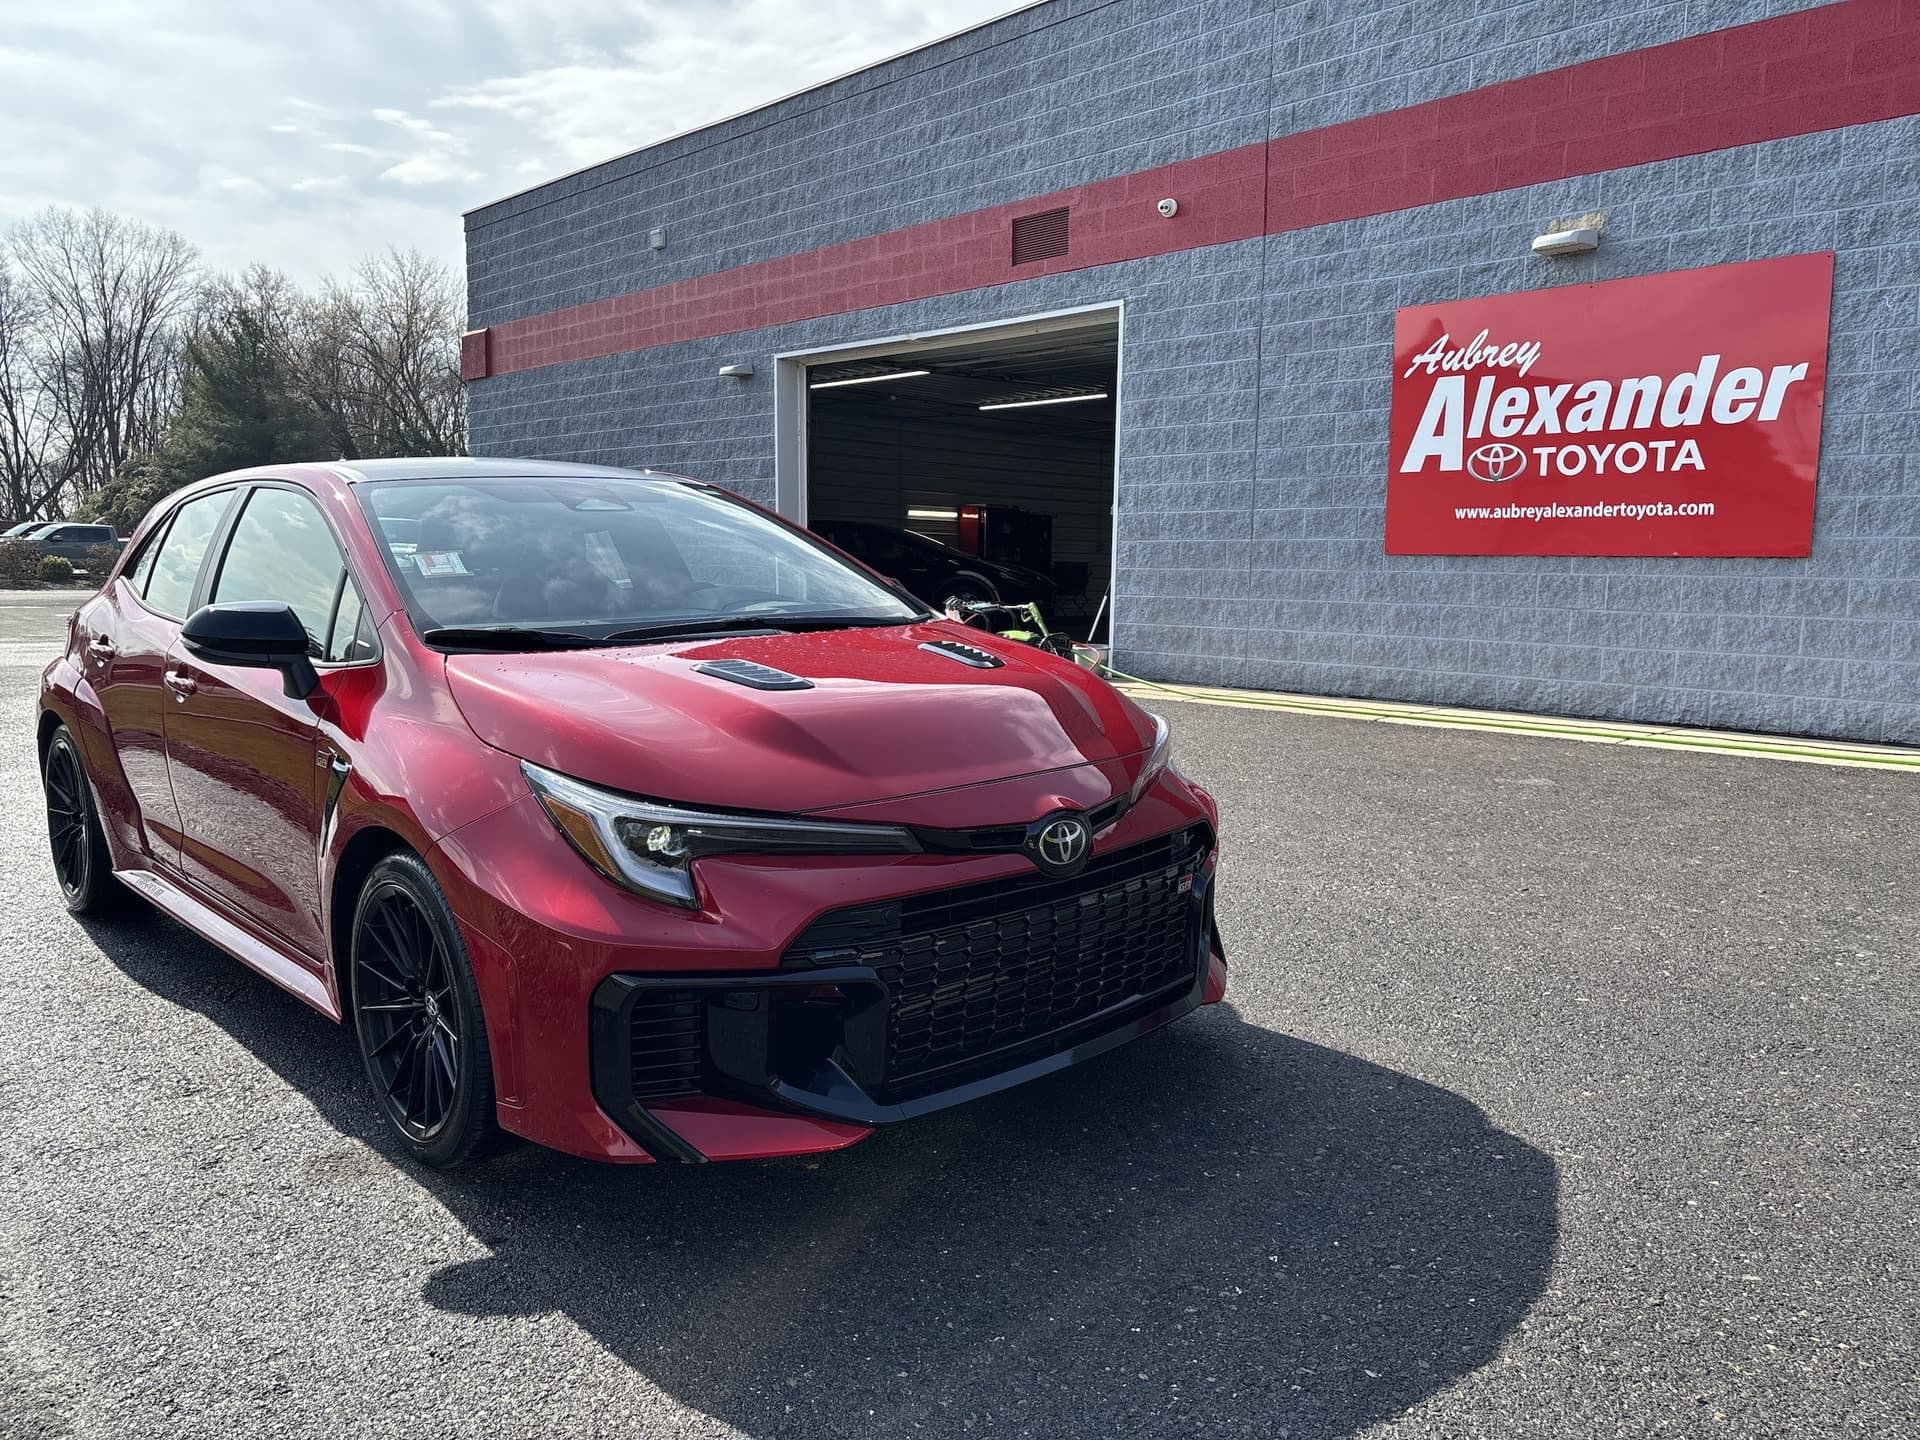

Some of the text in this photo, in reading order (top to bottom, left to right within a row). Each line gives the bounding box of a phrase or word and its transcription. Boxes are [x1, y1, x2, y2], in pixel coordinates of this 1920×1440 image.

[1404, 328, 1541, 378] Aubrey
[1400, 354, 1809, 473] Alexander
[1532, 439, 1705, 477] TOYOTA
[1454, 501, 1715, 522] www.aubreyalexandertoyota.com
